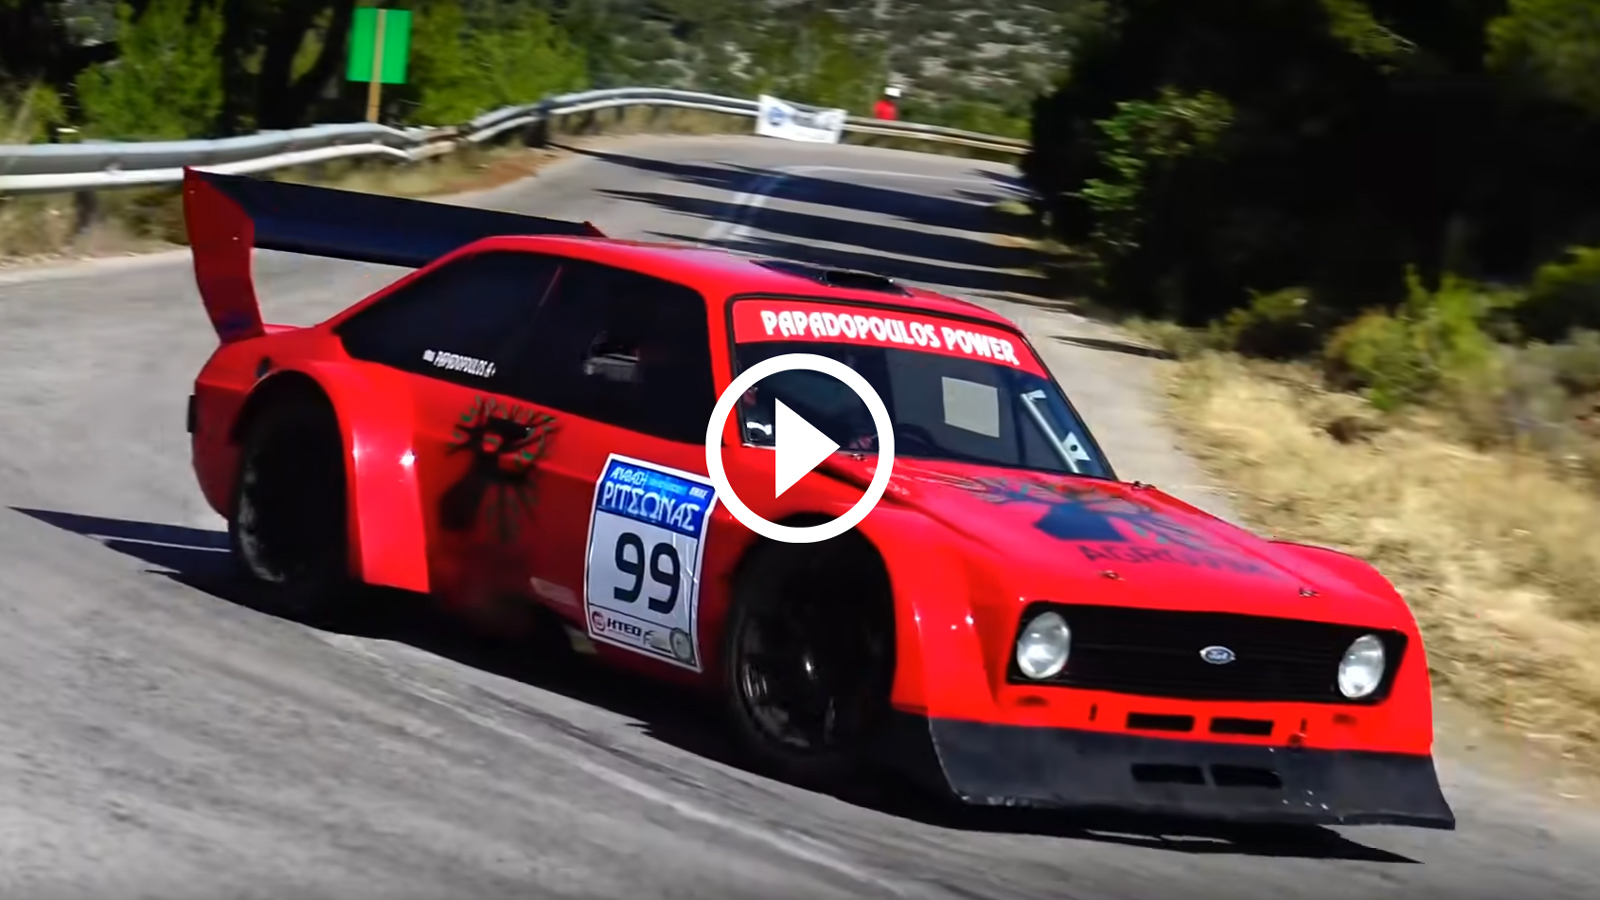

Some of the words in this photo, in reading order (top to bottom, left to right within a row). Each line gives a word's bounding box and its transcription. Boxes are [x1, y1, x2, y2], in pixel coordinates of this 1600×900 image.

[760, 310, 940, 348] PAPADOPOULOS
[940, 326, 1020, 366] POWER
[601, 481, 701, 532] ΡΙΤΣΩΝΑΣ
[613, 531, 681, 615] 99
